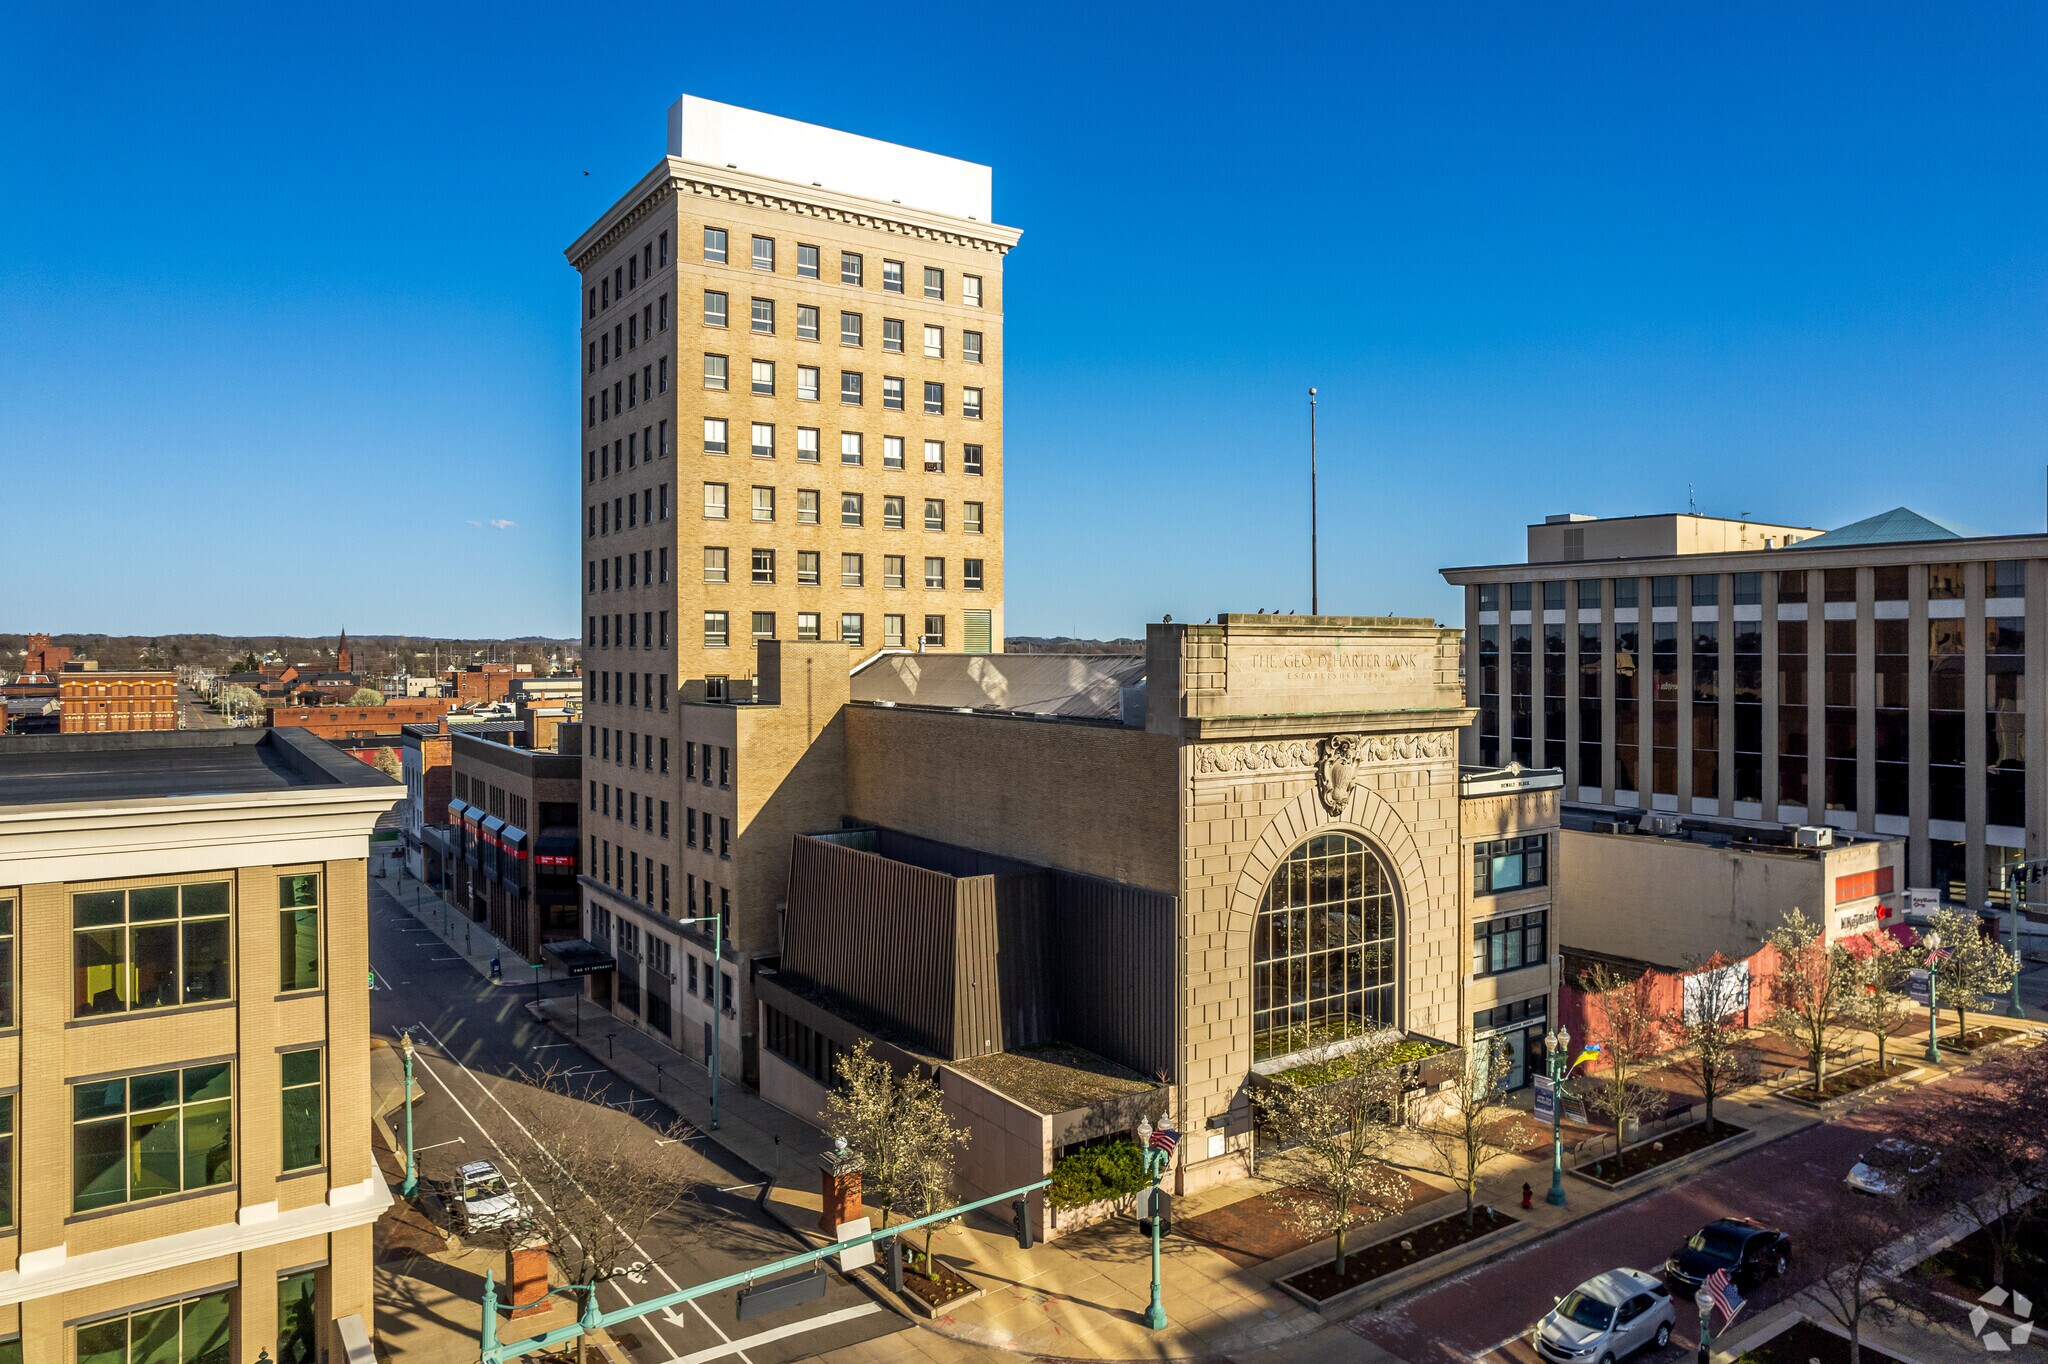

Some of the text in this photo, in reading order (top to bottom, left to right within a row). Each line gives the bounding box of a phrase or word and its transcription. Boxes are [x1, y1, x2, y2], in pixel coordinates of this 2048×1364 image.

[1250, 653, 1417, 668] THE GEO D HARTER BANK
[1287, 672, 1359, 680] ESTABLISHED
